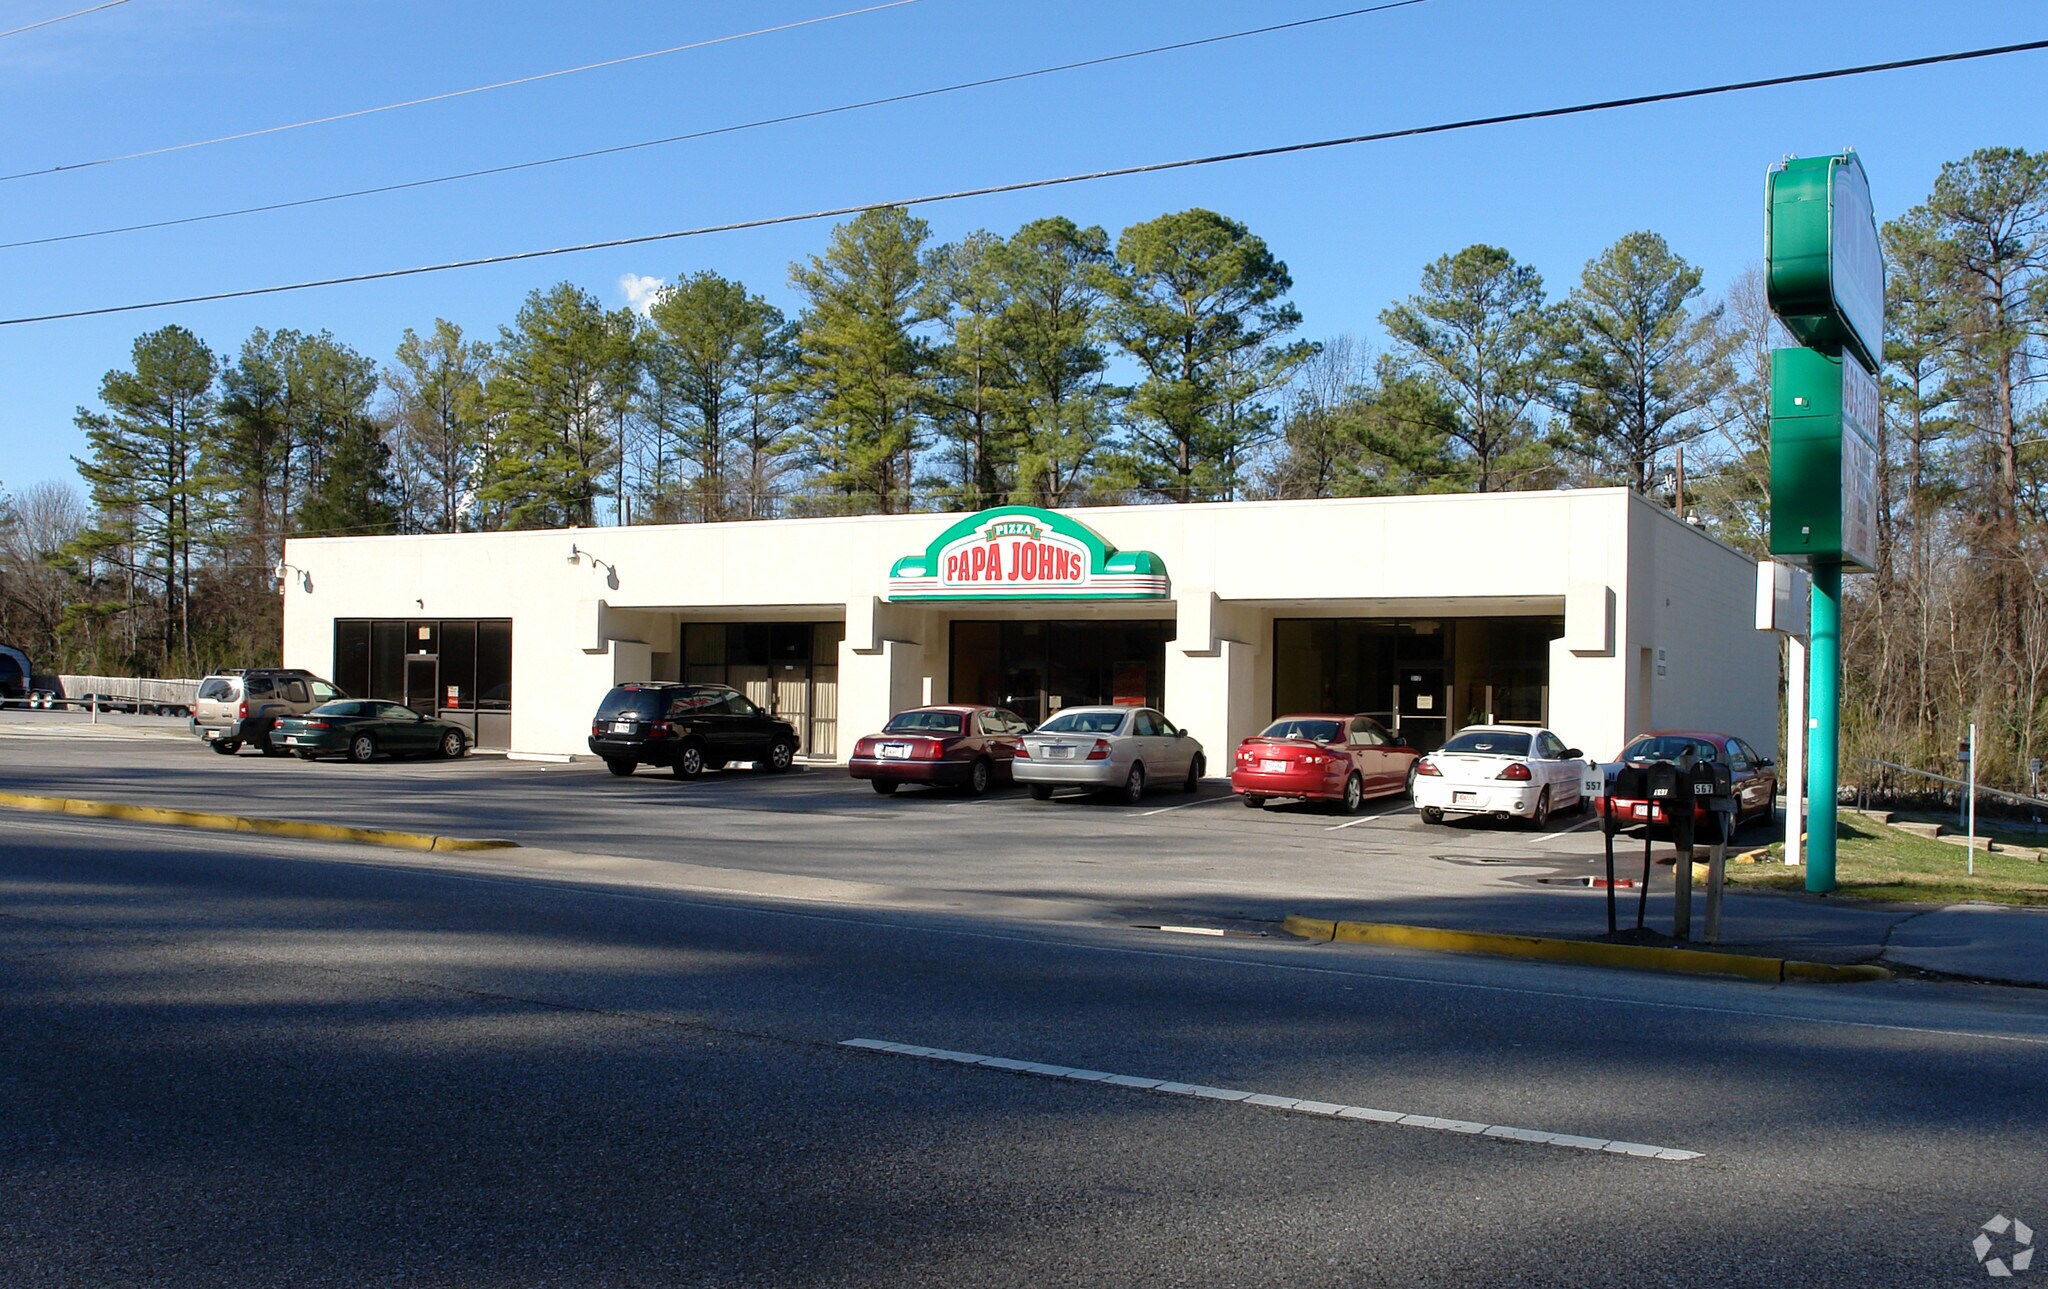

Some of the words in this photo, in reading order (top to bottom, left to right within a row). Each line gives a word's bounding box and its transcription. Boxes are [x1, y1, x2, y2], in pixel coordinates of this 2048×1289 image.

[995, 523, 1032, 535] PIZZA
[947, 543, 1002, 581] PAPA
[1585, 781, 1601, 791] 557
[1695, 784, 1712, 794] 567
